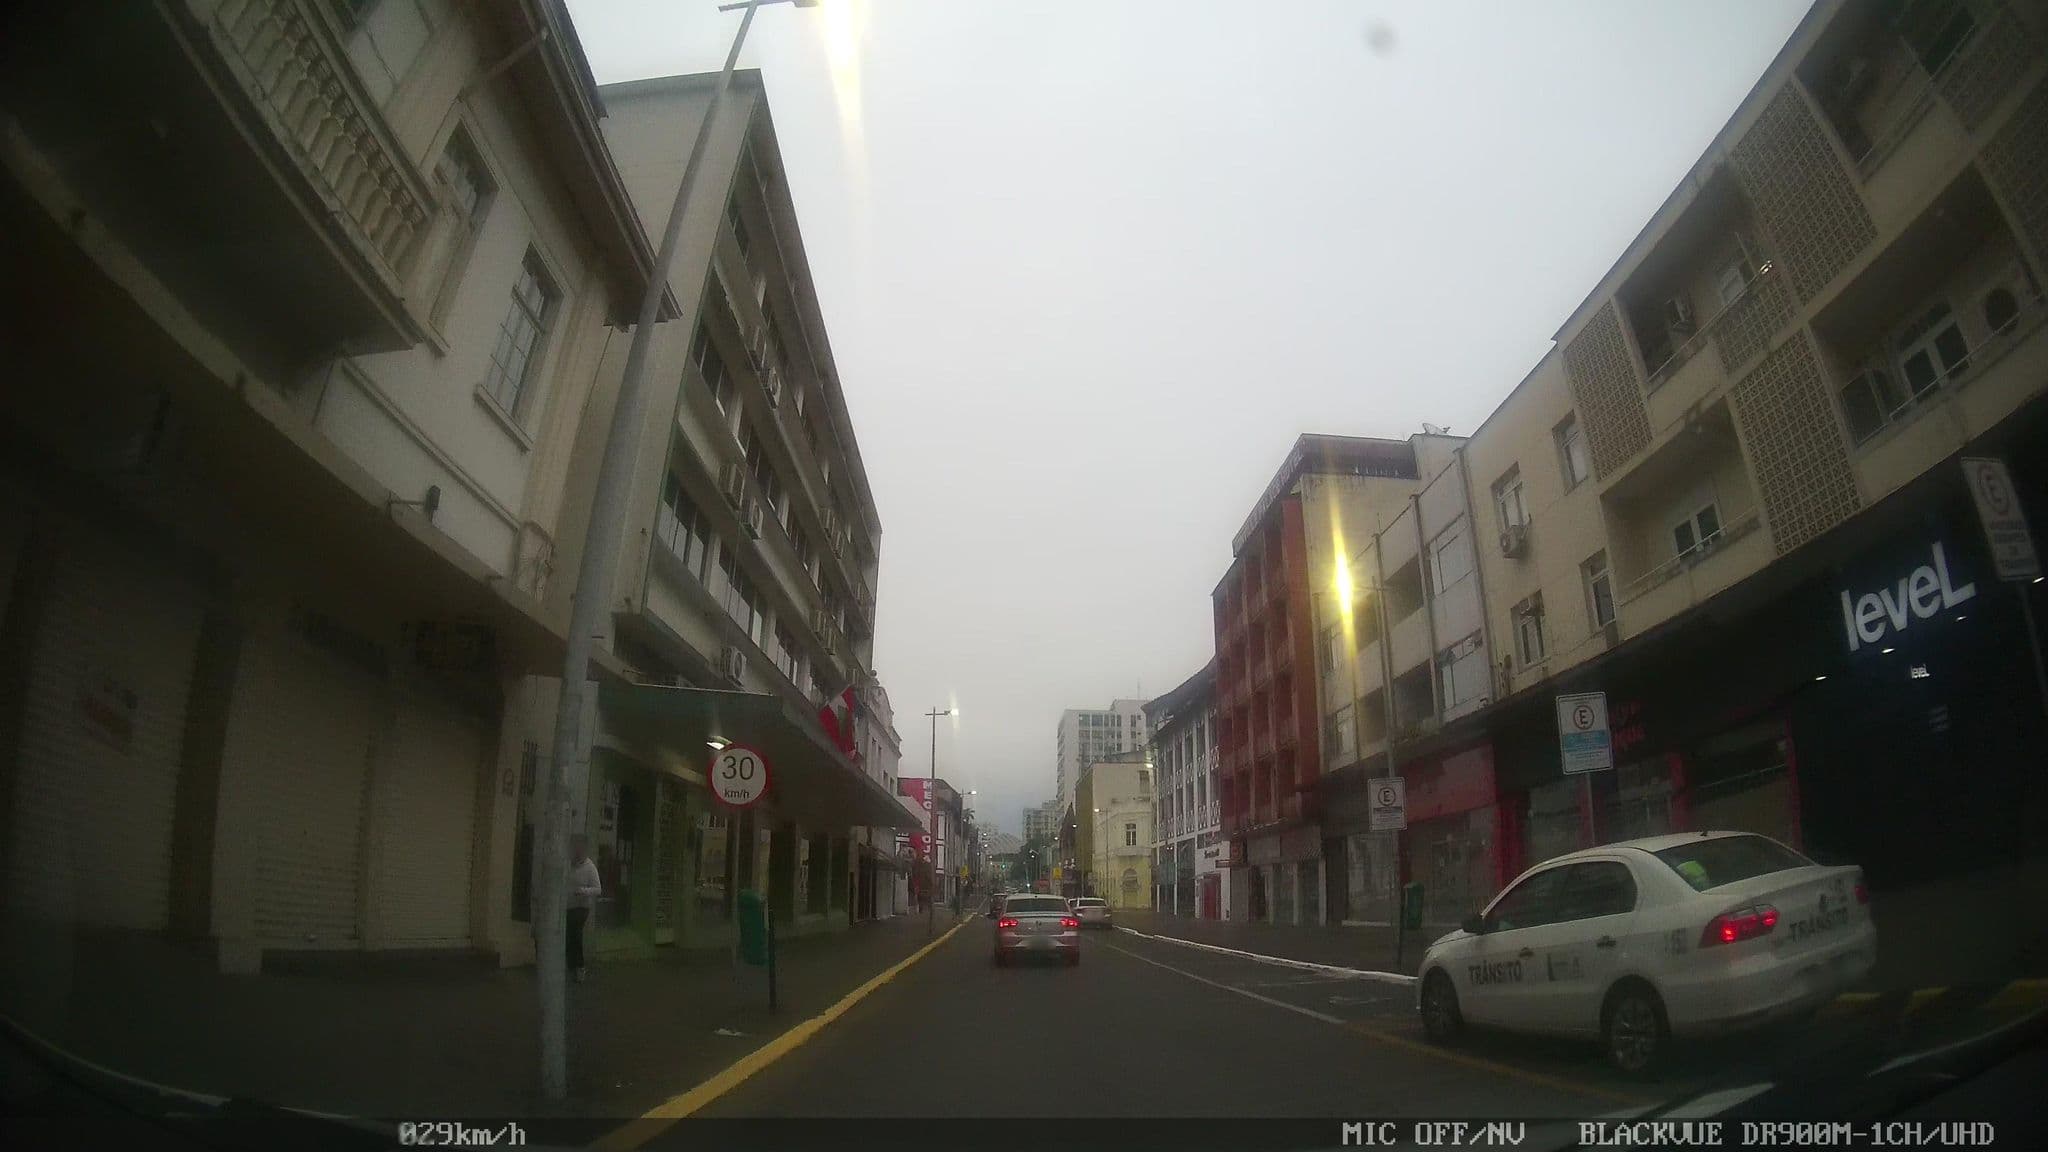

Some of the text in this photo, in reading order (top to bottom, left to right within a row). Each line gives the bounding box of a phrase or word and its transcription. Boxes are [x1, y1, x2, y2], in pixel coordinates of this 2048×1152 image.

[1578, 709, 1589, 725] E
[721, 755, 754, 781] 30
[724, 788, 750, 799] km/h
[1383, 789, 1392, 803] E
[1467, 959, 1523, 985] TRÂNSITO
